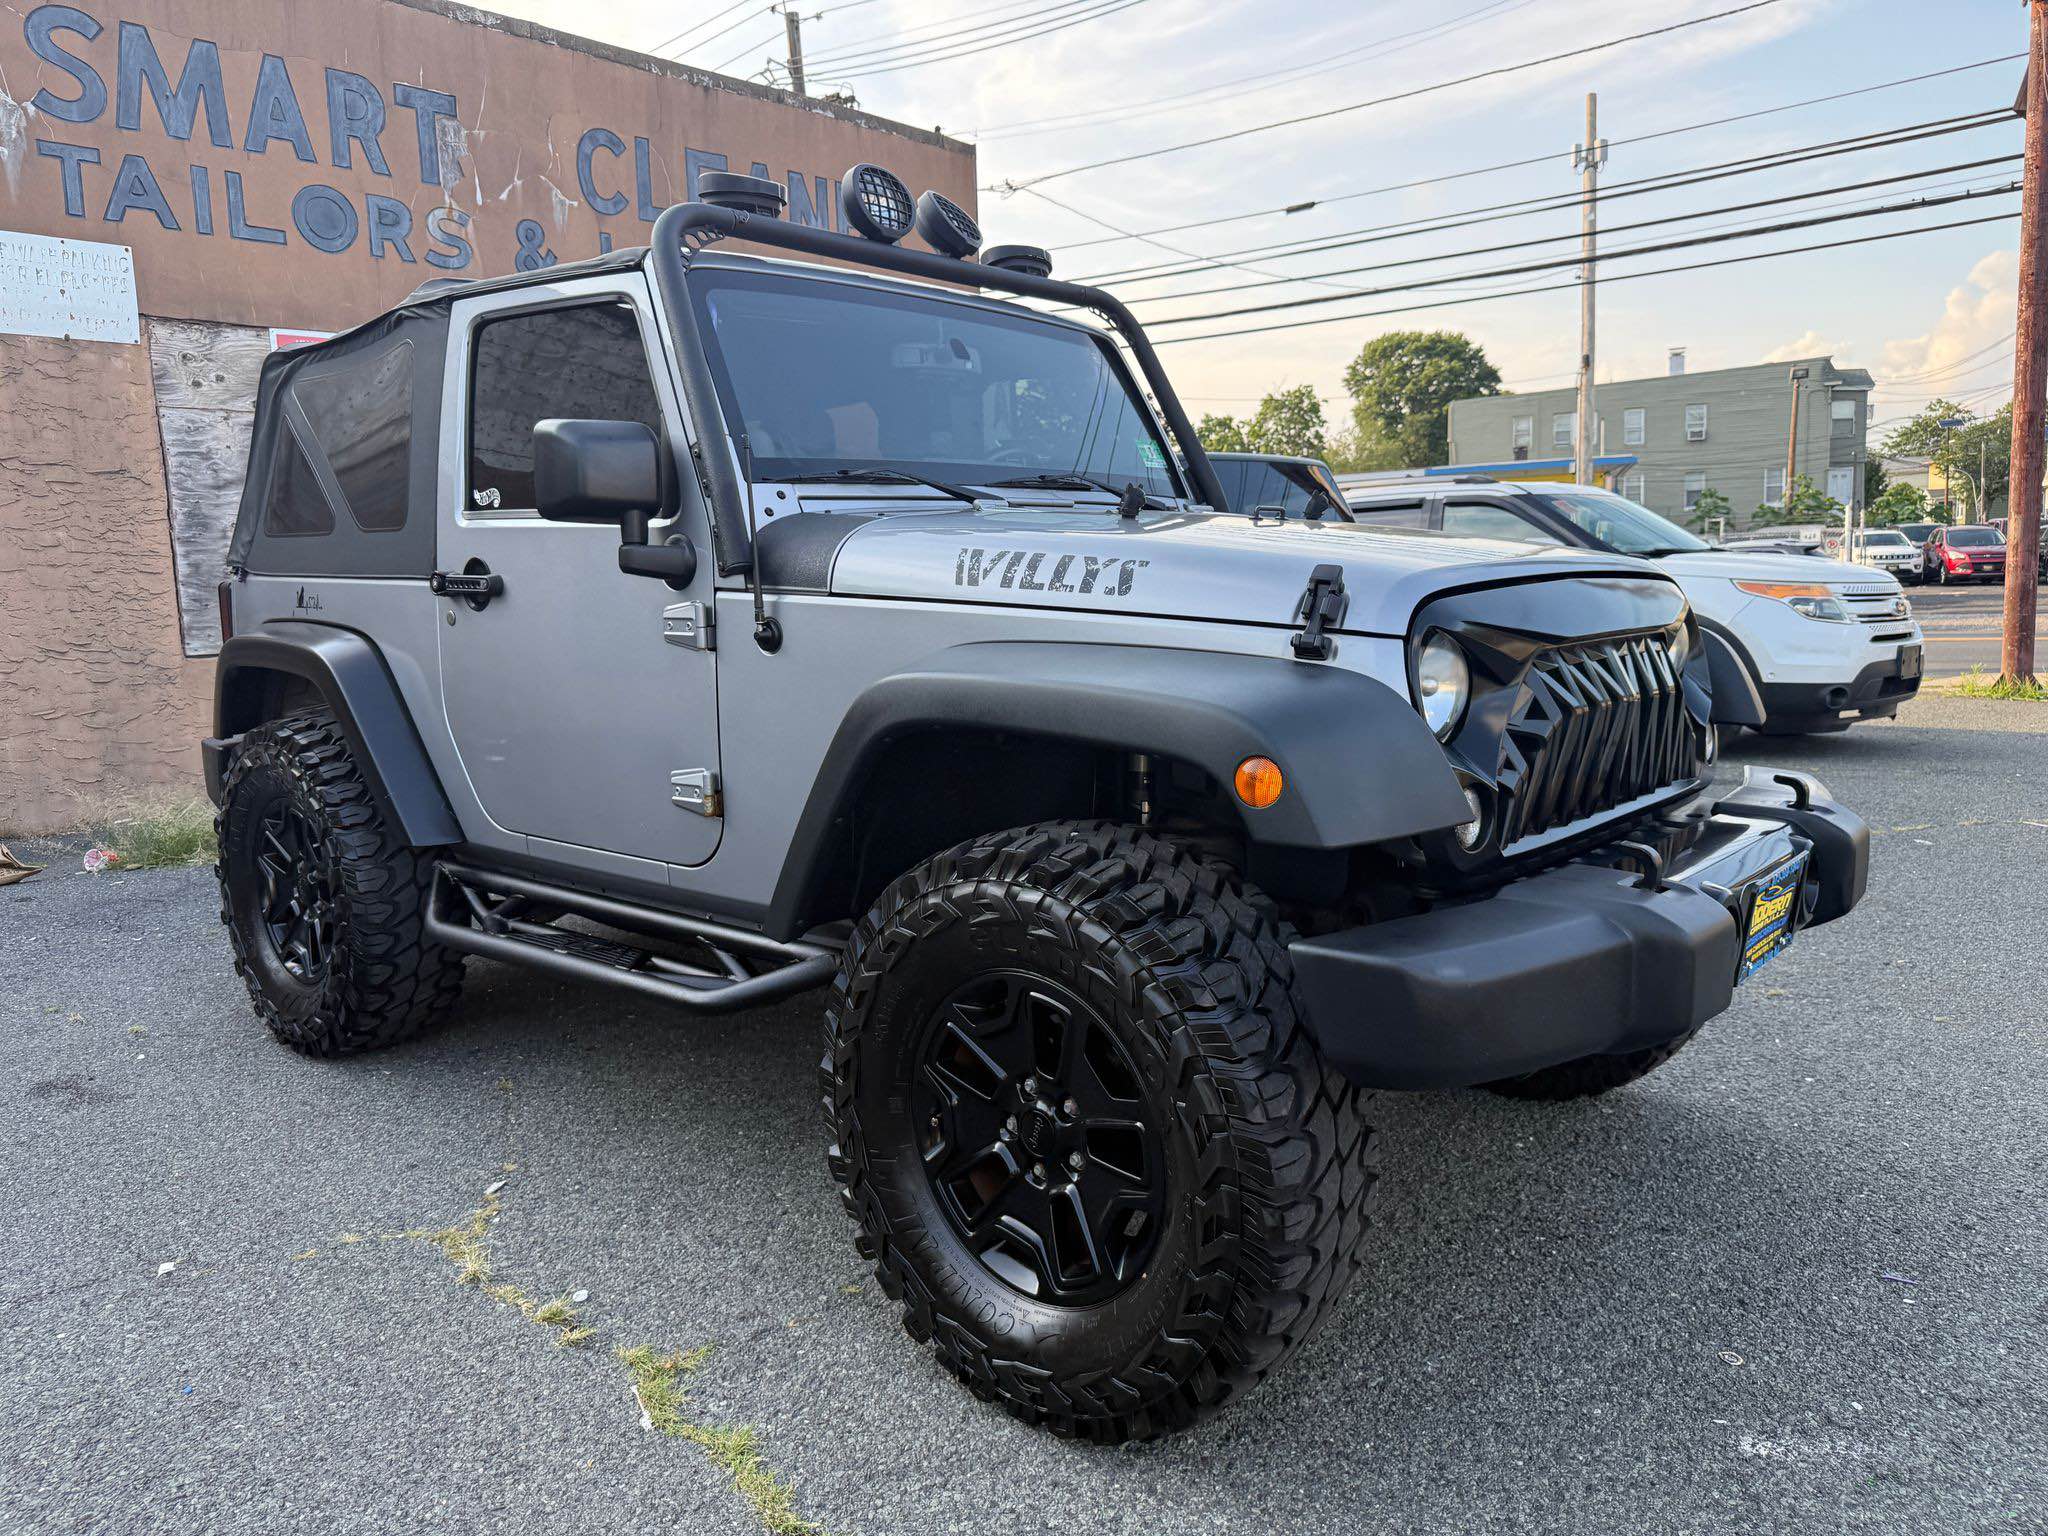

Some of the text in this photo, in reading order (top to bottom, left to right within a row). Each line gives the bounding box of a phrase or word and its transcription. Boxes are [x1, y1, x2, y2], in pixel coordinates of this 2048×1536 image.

[23, 5, 458, 186] SMART
[36, 138, 558, 272] TAILORS &
[955, 548, 1150, 597] WILLYS
